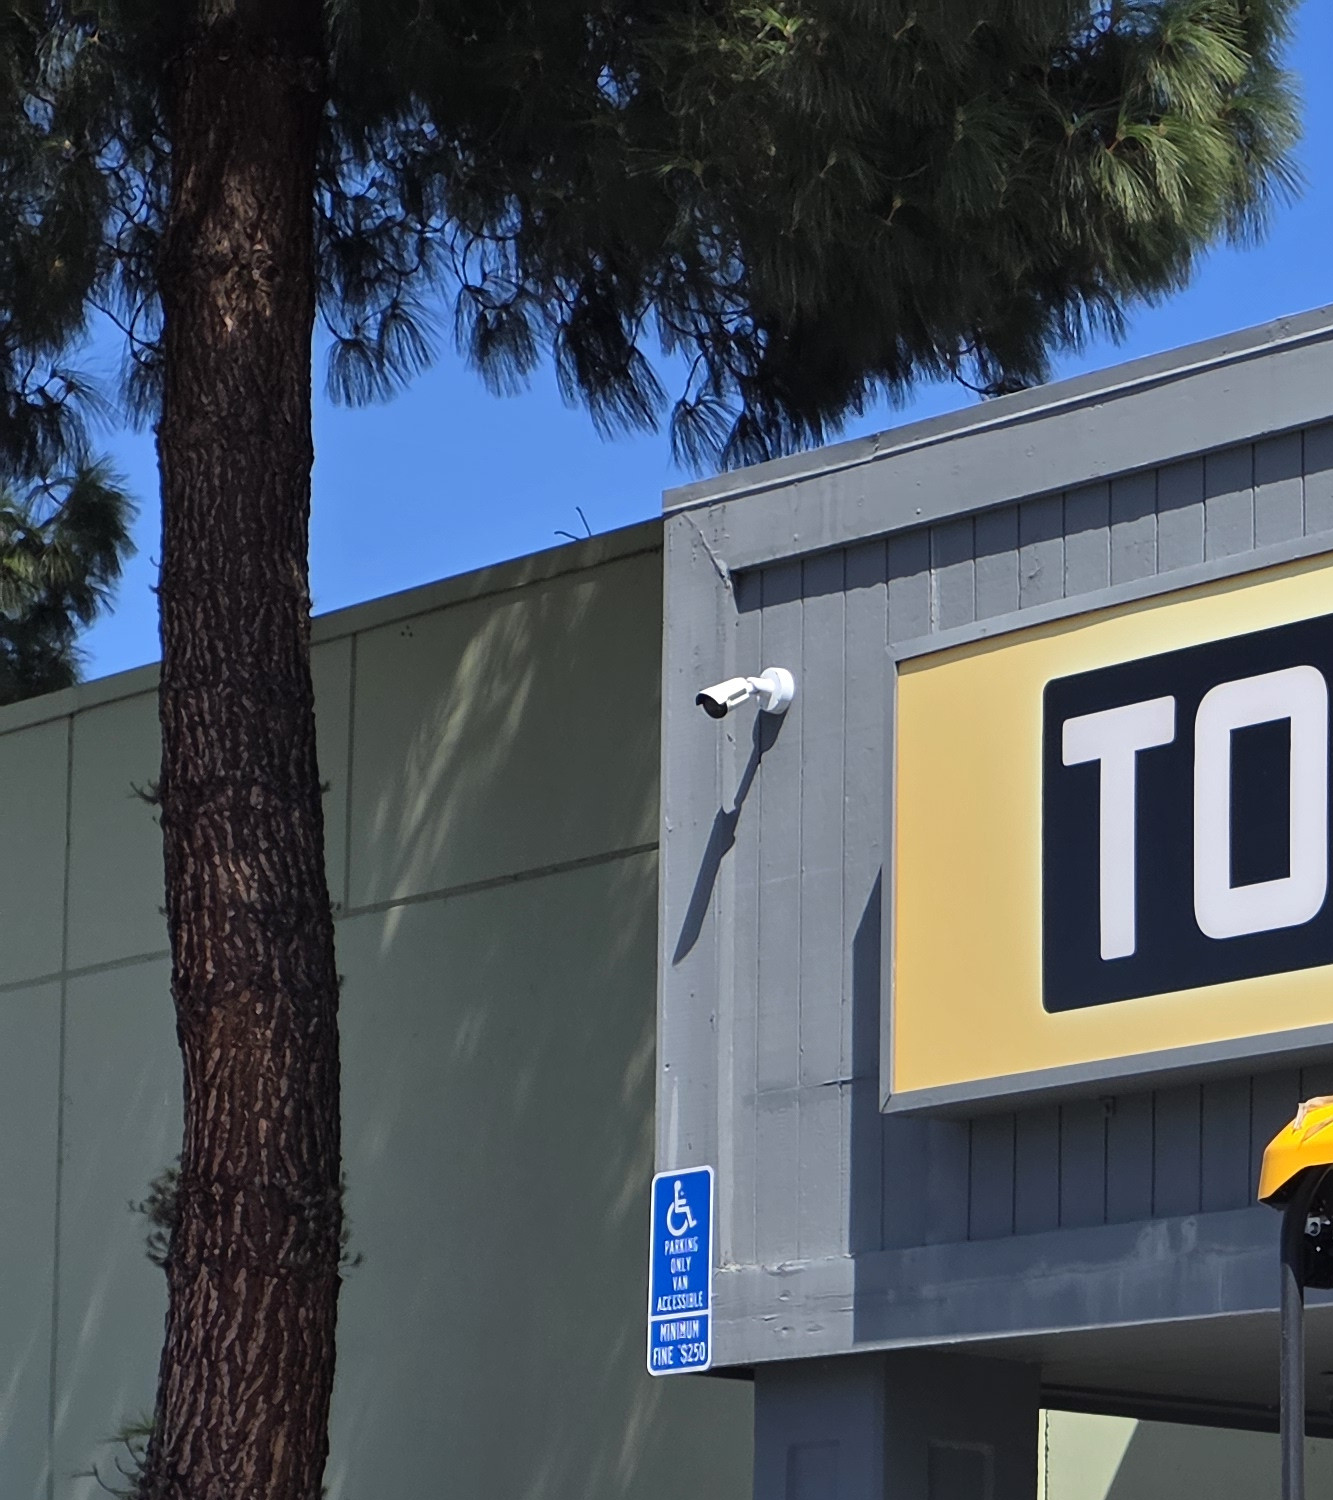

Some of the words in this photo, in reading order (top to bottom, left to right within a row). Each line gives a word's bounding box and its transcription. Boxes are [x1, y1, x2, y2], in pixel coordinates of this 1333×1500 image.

[664, 1236, 699, 1256] PARKING
[670, 1256, 691, 1274] ONLY
[672, 1275, 688, 1291] VAN
[657, 1291, 703, 1312] ACCESSIBLE
[660, 1320, 699, 1342] MINIMUM
[653, 1345, 674, 1366] FINE
[679, 1341, 706, 1365] $250
